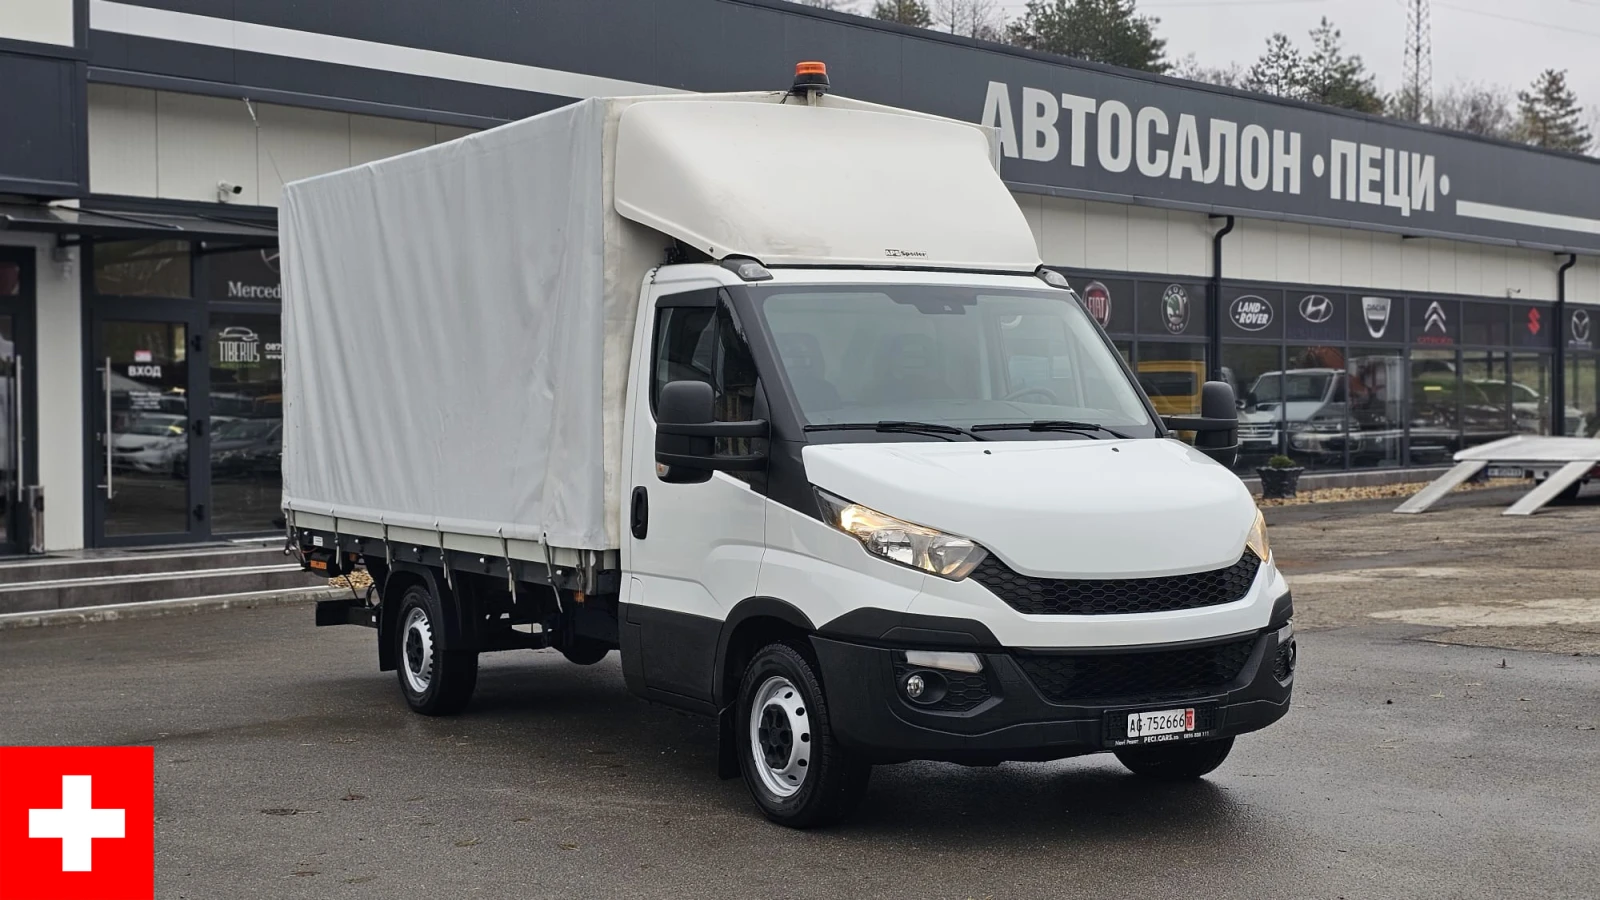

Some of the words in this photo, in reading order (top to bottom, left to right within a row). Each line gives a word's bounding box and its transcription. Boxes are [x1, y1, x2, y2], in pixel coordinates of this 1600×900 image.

[981, 80, 1301, 195] АВТОСАЛОН
[1330, 138, 1436, 217] ПЕЦИ
[1088, 296, 1106, 319] FIAT
[218, 341, 260, 362] TIBERUS
[128, 365, 162, 378] ВХОД
